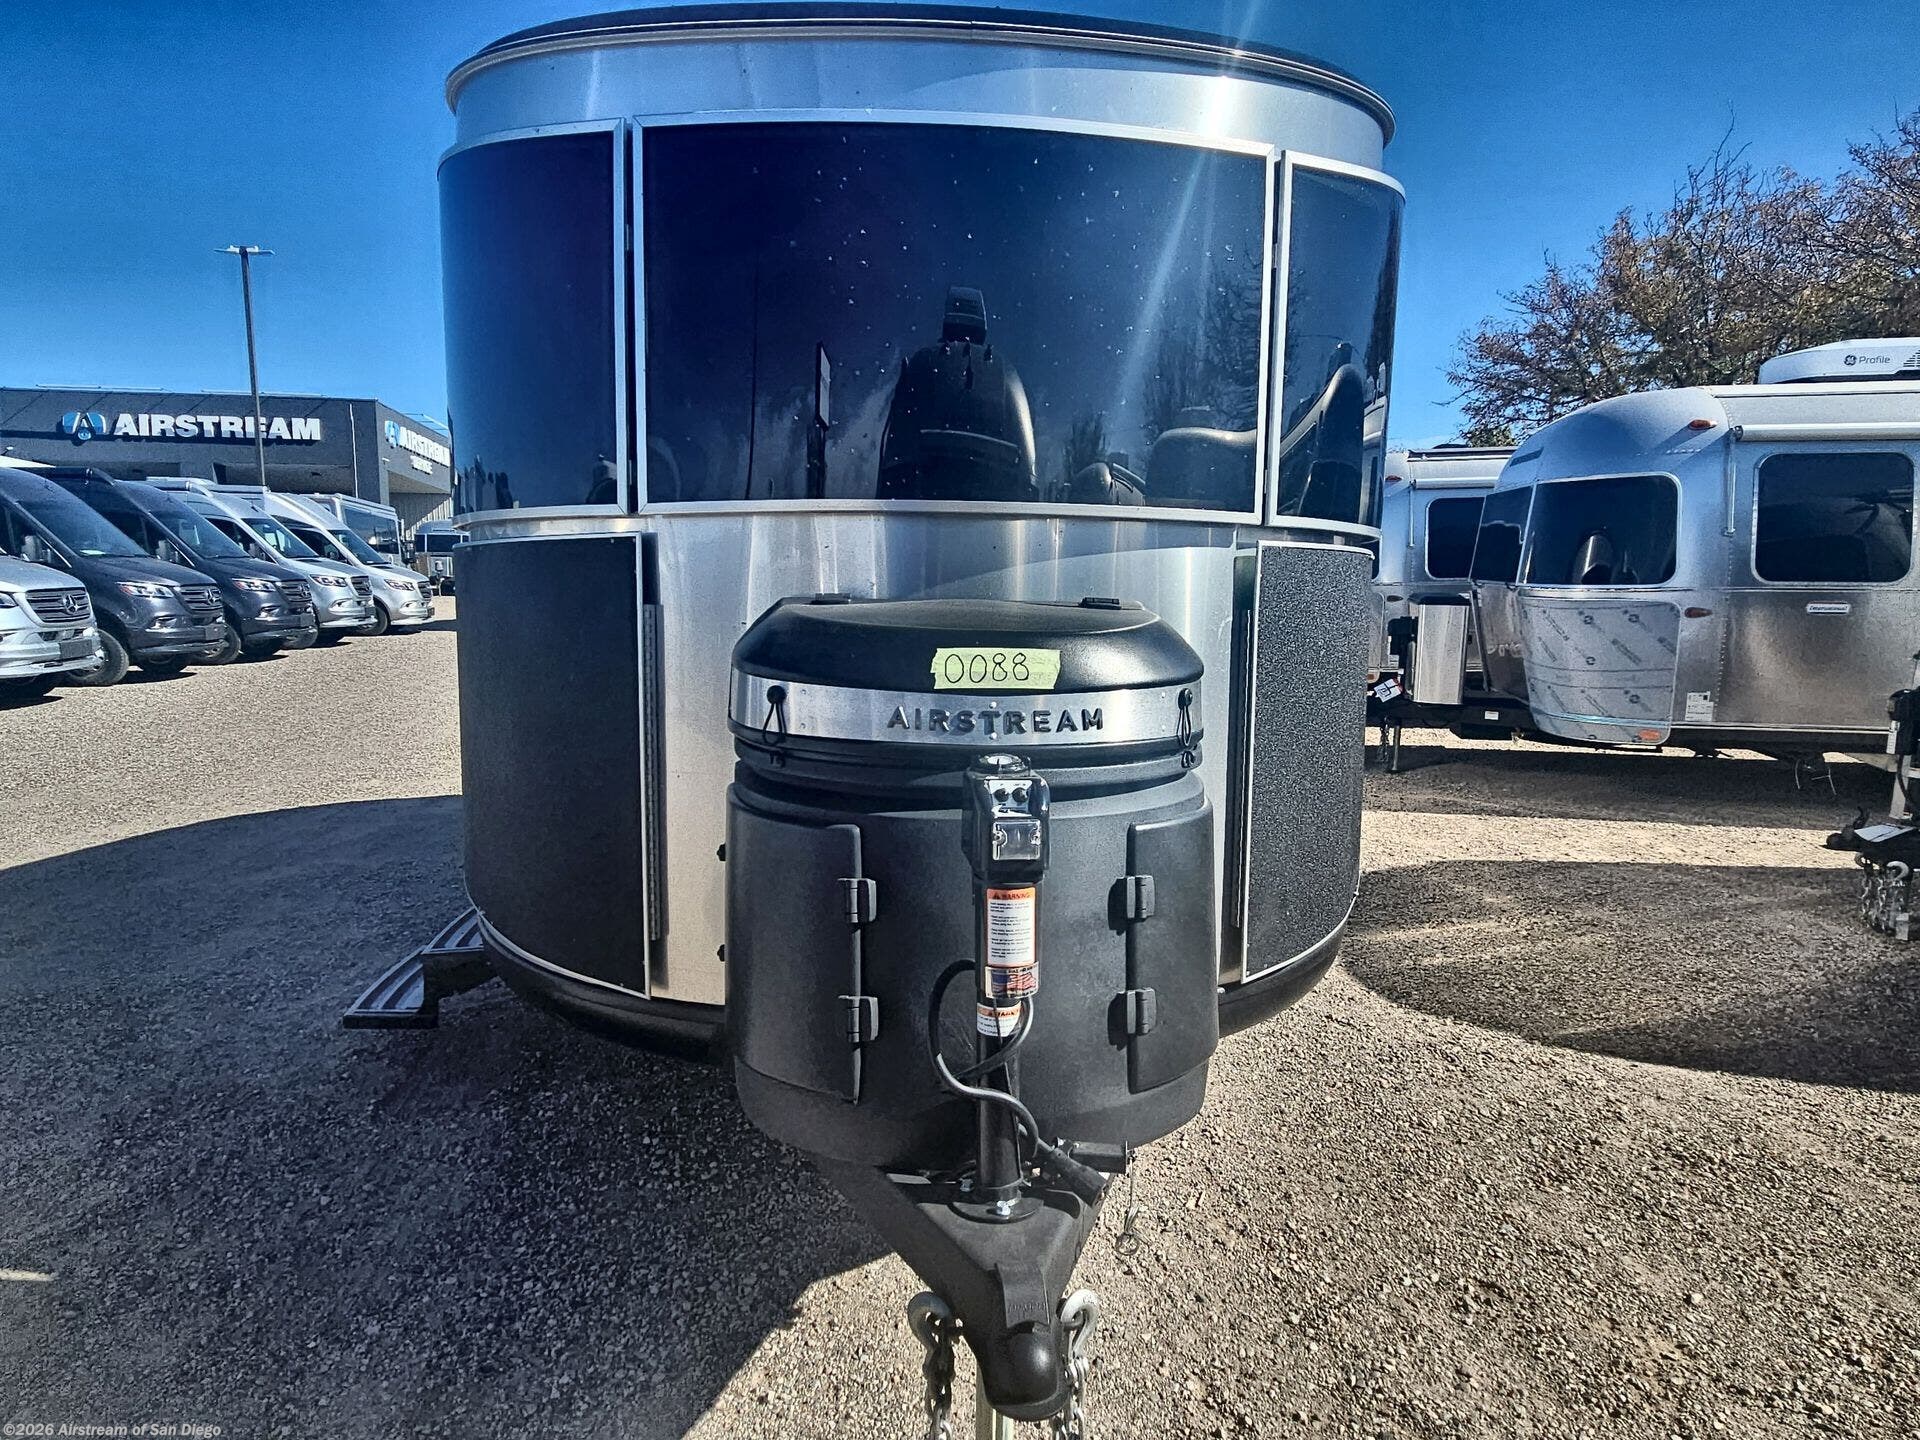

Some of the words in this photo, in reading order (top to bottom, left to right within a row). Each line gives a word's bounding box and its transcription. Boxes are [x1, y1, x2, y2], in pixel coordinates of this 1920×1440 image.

[1859, 355, 1890, 364] Profile
[114, 413, 321, 441] AIRSTREAM
[944, 653, 1029, 683] 0088
[887, 705, 1103, 735] AIRSTREAM
